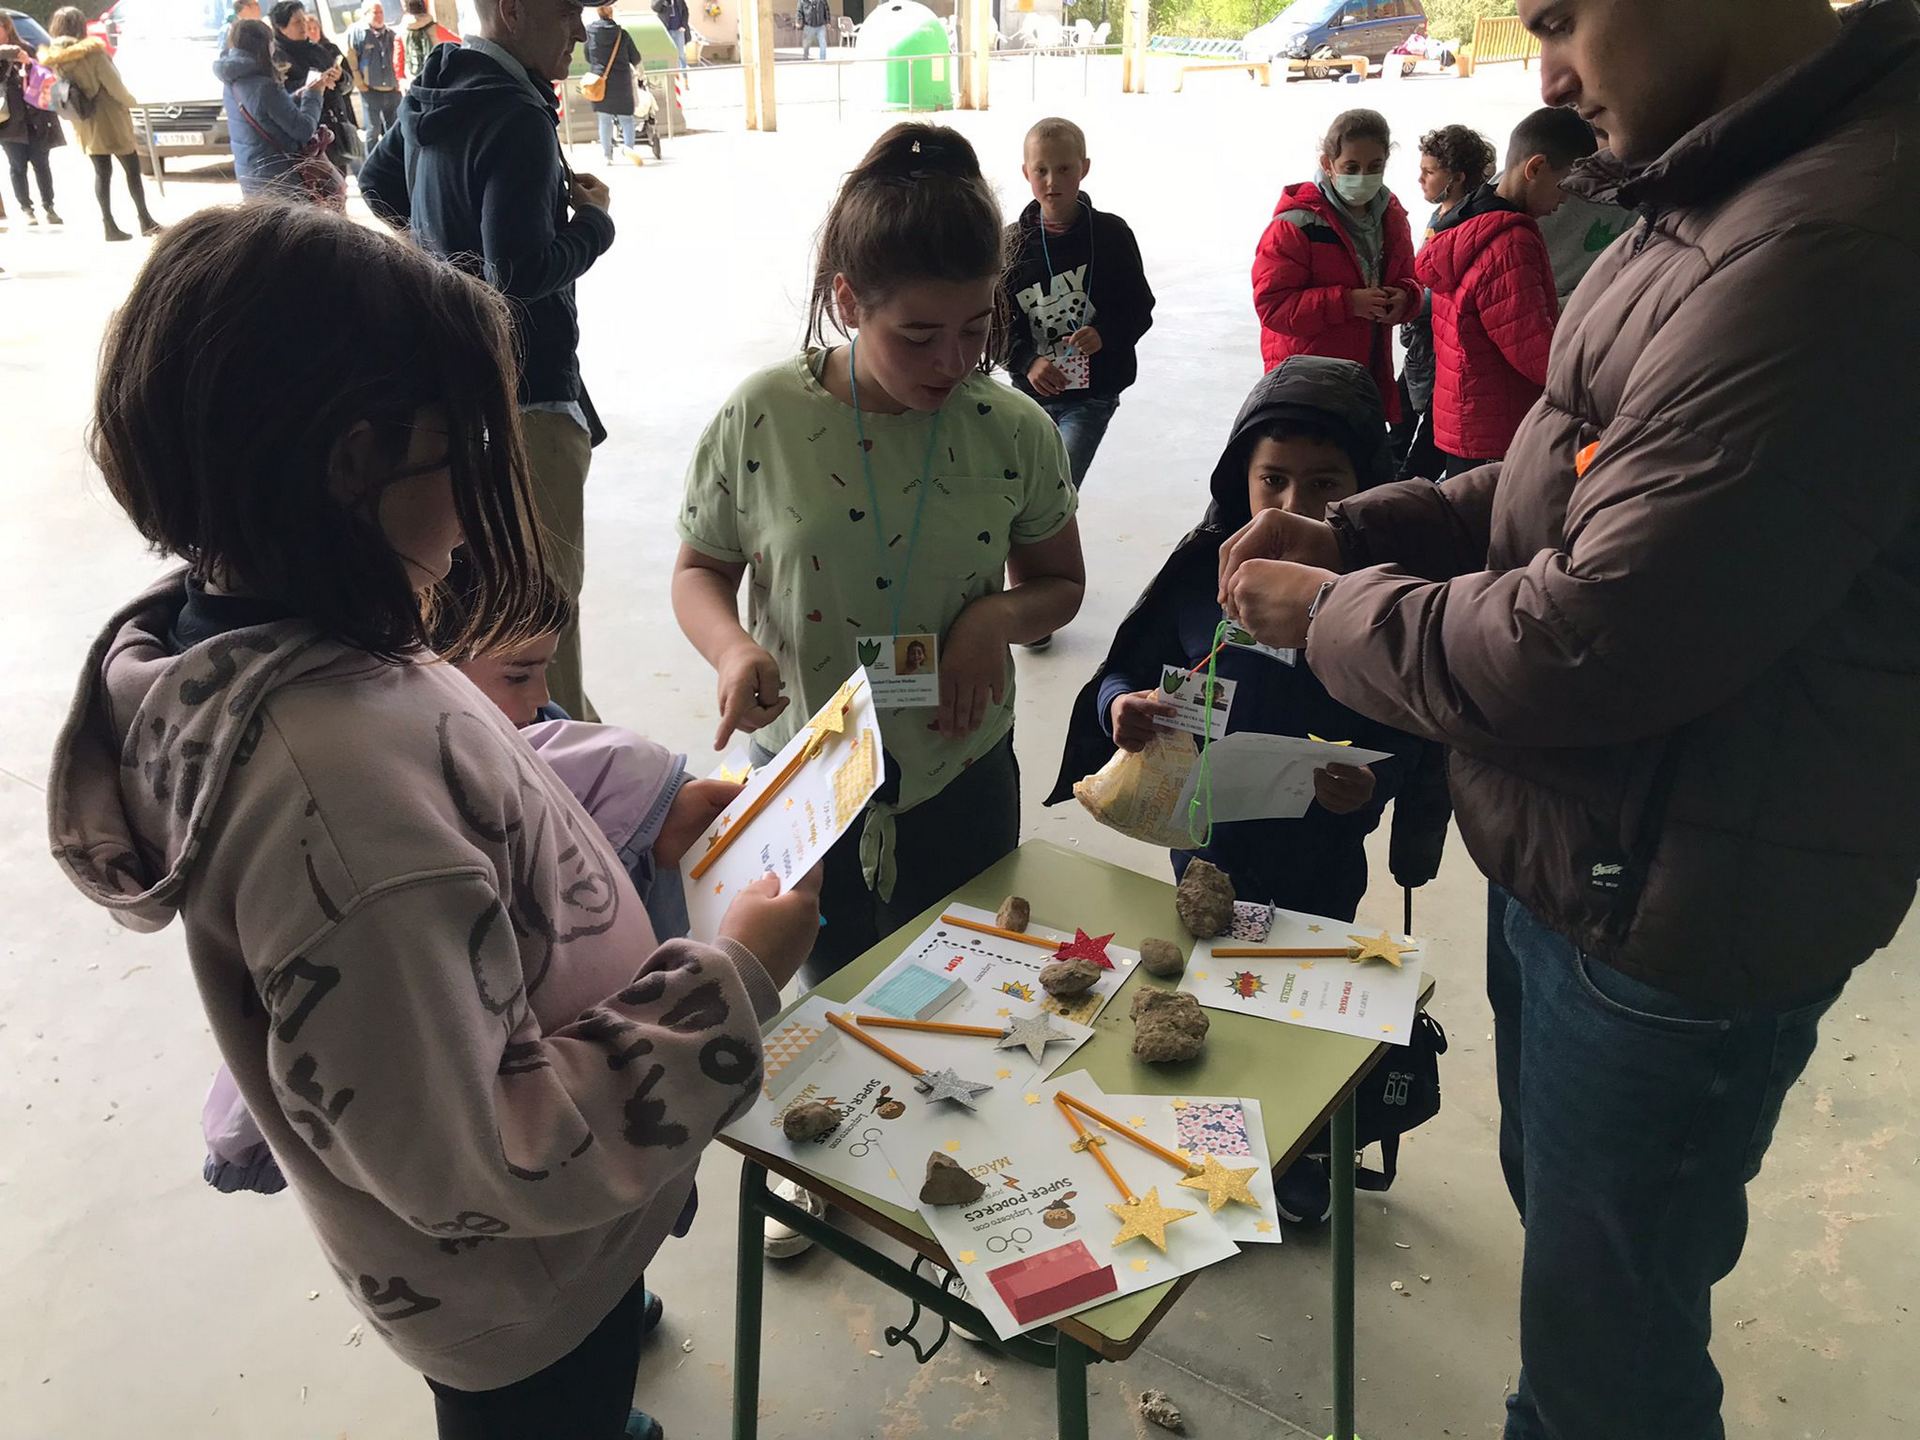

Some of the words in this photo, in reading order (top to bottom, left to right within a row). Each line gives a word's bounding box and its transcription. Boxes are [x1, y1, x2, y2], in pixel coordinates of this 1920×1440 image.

[1015, 264, 1087, 314] PLAY
[807, 426, 827, 442] Love
[932, 478, 951, 495] Love
[851, 1079, 881, 1105] SUPER
[967, 1156, 1014, 1179] MÁGI
[1027, 1178, 1073, 1199] SUPER
[964, 1193, 1028, 1223] PODERES
[990, 1207, 1034, 1227] Lapicero
[973, 1221, 991, 1232] con
